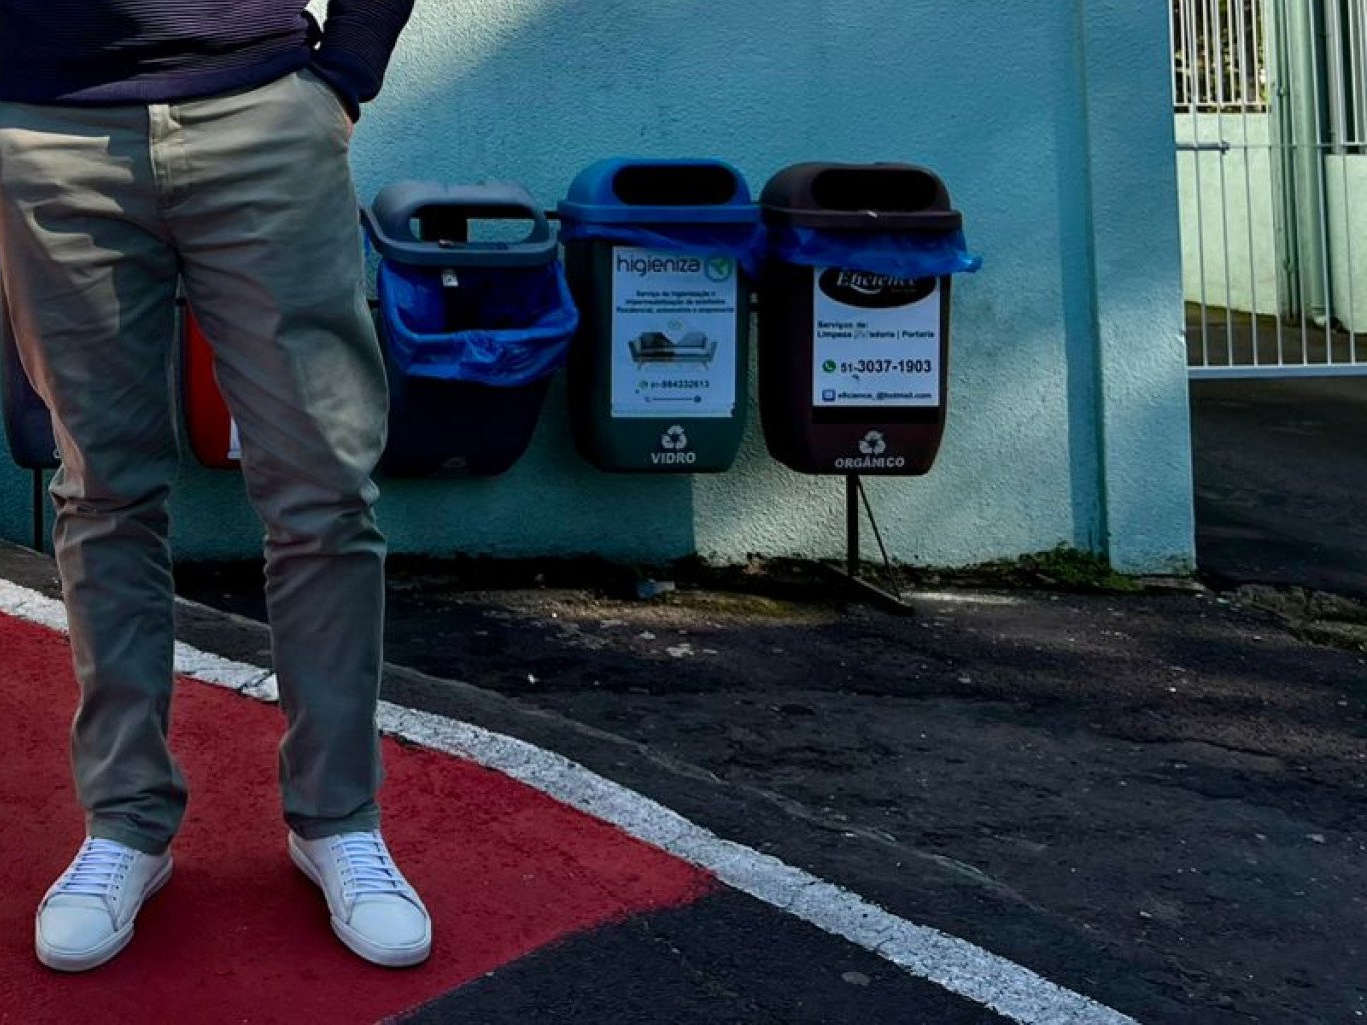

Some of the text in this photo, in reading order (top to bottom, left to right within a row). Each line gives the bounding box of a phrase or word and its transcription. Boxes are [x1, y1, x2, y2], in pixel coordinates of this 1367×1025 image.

[616, 254, 701, 277] higieniza
[840, 358, 932, 373] 51-3037-1903
[650, 452, 697, 464] VIDRO
[834, 454, 906, 468] ORGÂNICO
